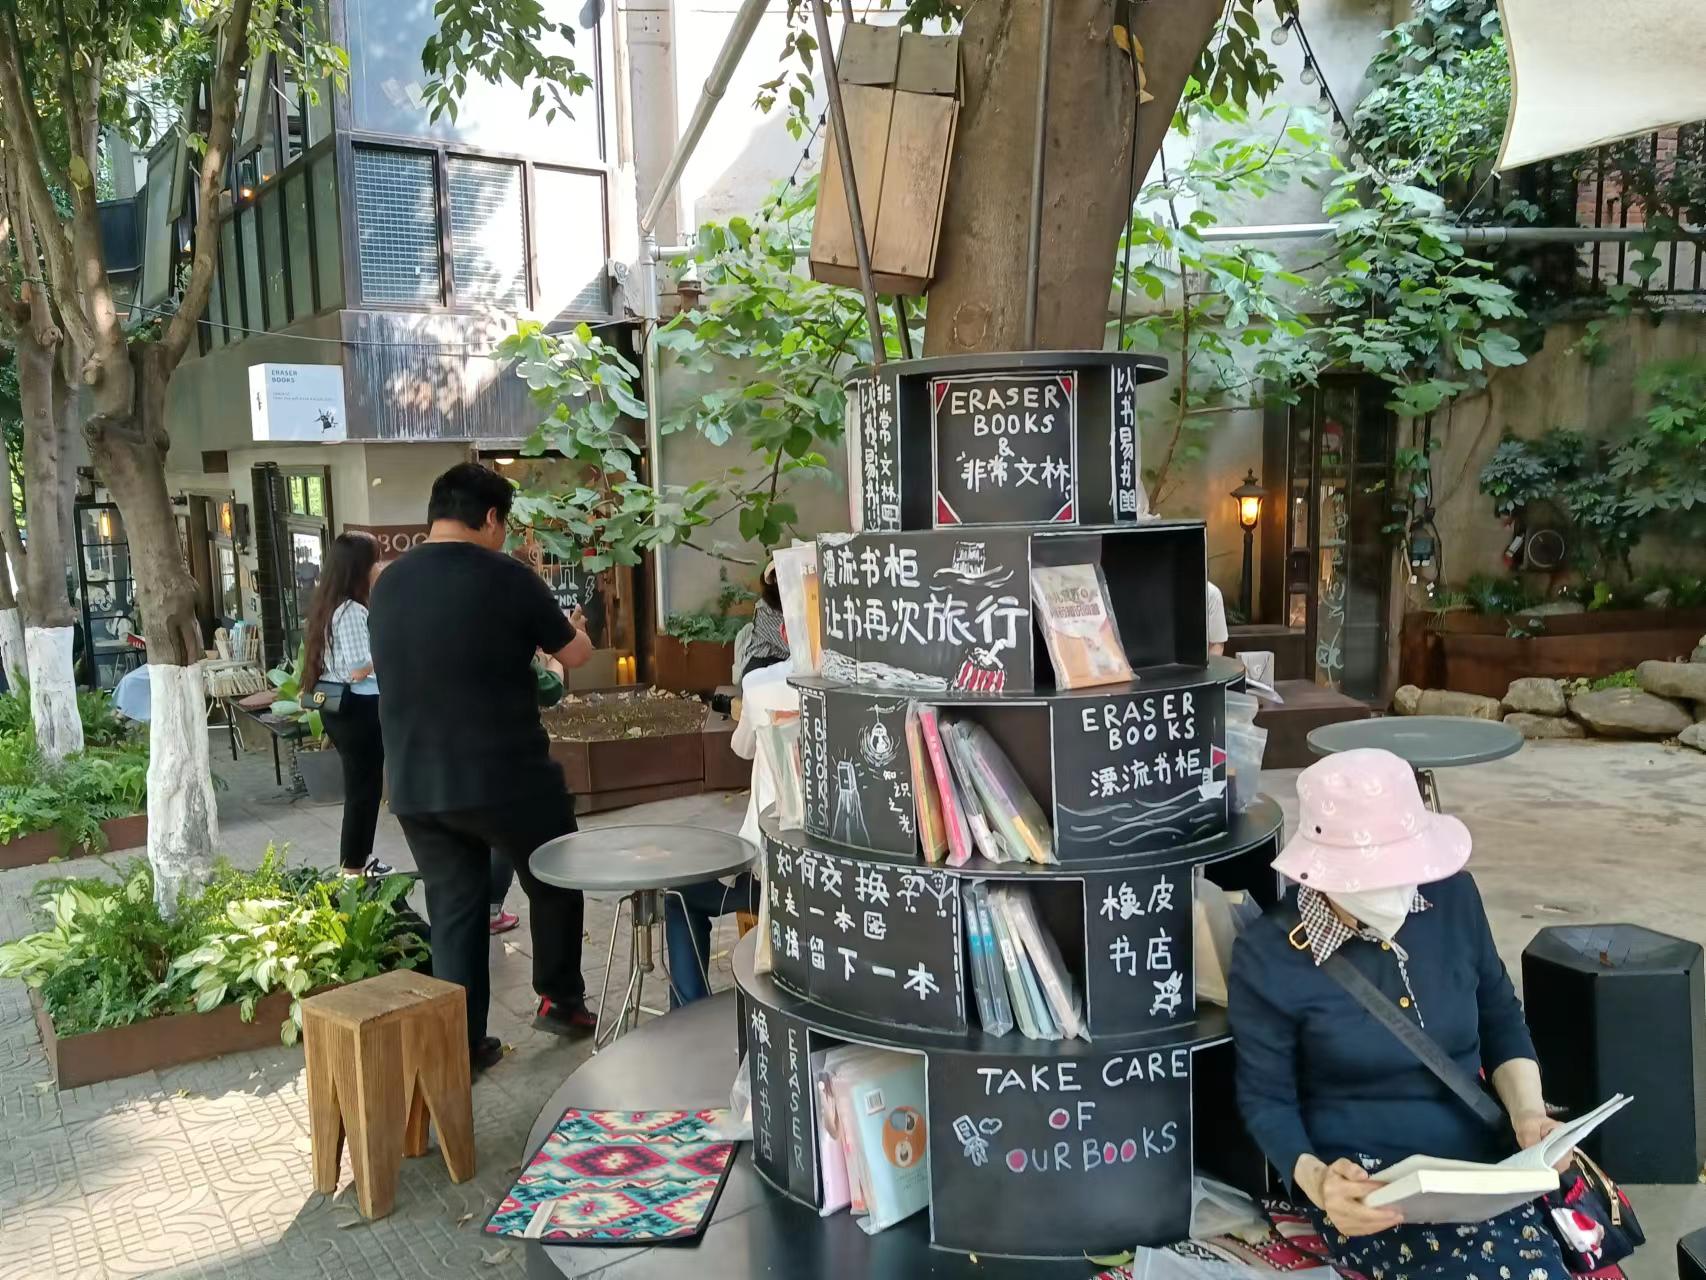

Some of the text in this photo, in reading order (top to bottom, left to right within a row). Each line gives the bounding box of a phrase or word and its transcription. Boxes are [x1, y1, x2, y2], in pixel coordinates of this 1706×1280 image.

[271, 369, 298, 377] ERASER
[271, 376, 296, 384] BOOKS
[950, 385, 1061, 416] ERASER
[973, 413, 1056, 437] BOOKS
[998, 436, 1016, 458] &
[1116, 366, 1135, 488] 以书易书
[960, 454, 1072, 493] 非常文林
[824, 593, 1030, 649] 让书再次旅行
[1081, 691, 1196, 732] ERASER
[1109, 717, 1196, 751] BOOKS
[1089, 748, 1203, 798] 漂流书柜
[776, 848, 890, 907] 如何交换
[1100, 873, 1175, 920] 橡皮
[1108, 927, 1173, 978] 书店
[976, 1048, 1189, 1096] TAKE CARE
[788, 1027, 805, 1172] ERASER
[1048, 1101, 1097, 1132] OF
[1005, 1121, 1178, 1174] OUR BOOKS
